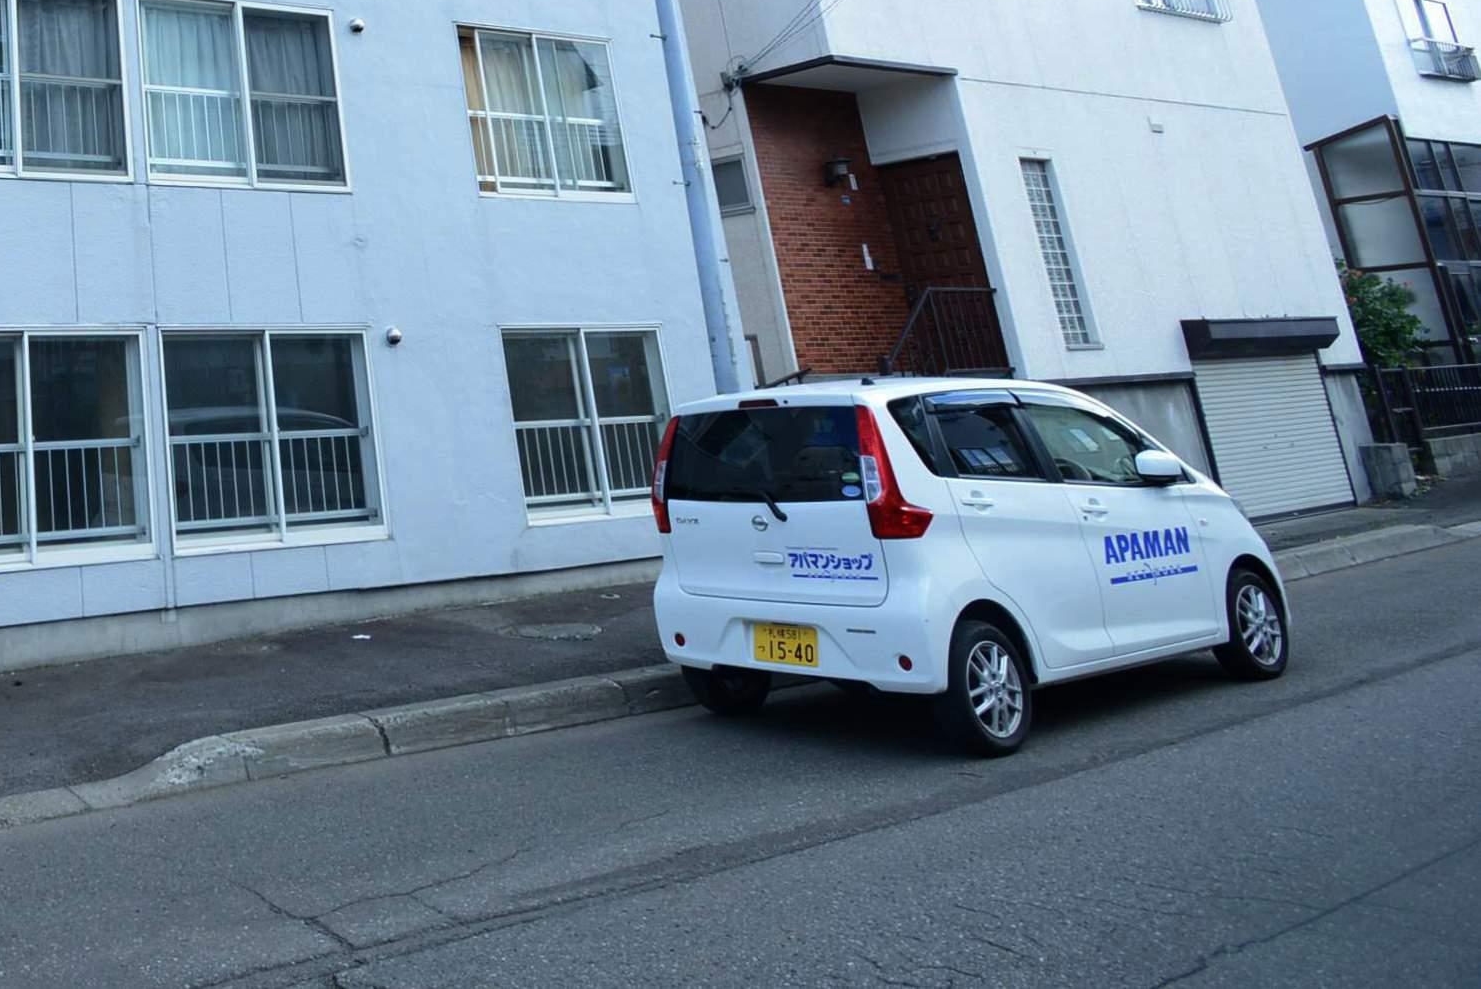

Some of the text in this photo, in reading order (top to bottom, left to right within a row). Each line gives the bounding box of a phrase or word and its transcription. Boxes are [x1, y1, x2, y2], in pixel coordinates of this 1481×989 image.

[1103, 526, 1191, 564] APAMAN
[787, 551, 874, 571] アパマンショップ
[769, 640, 815, 663] 15-40
